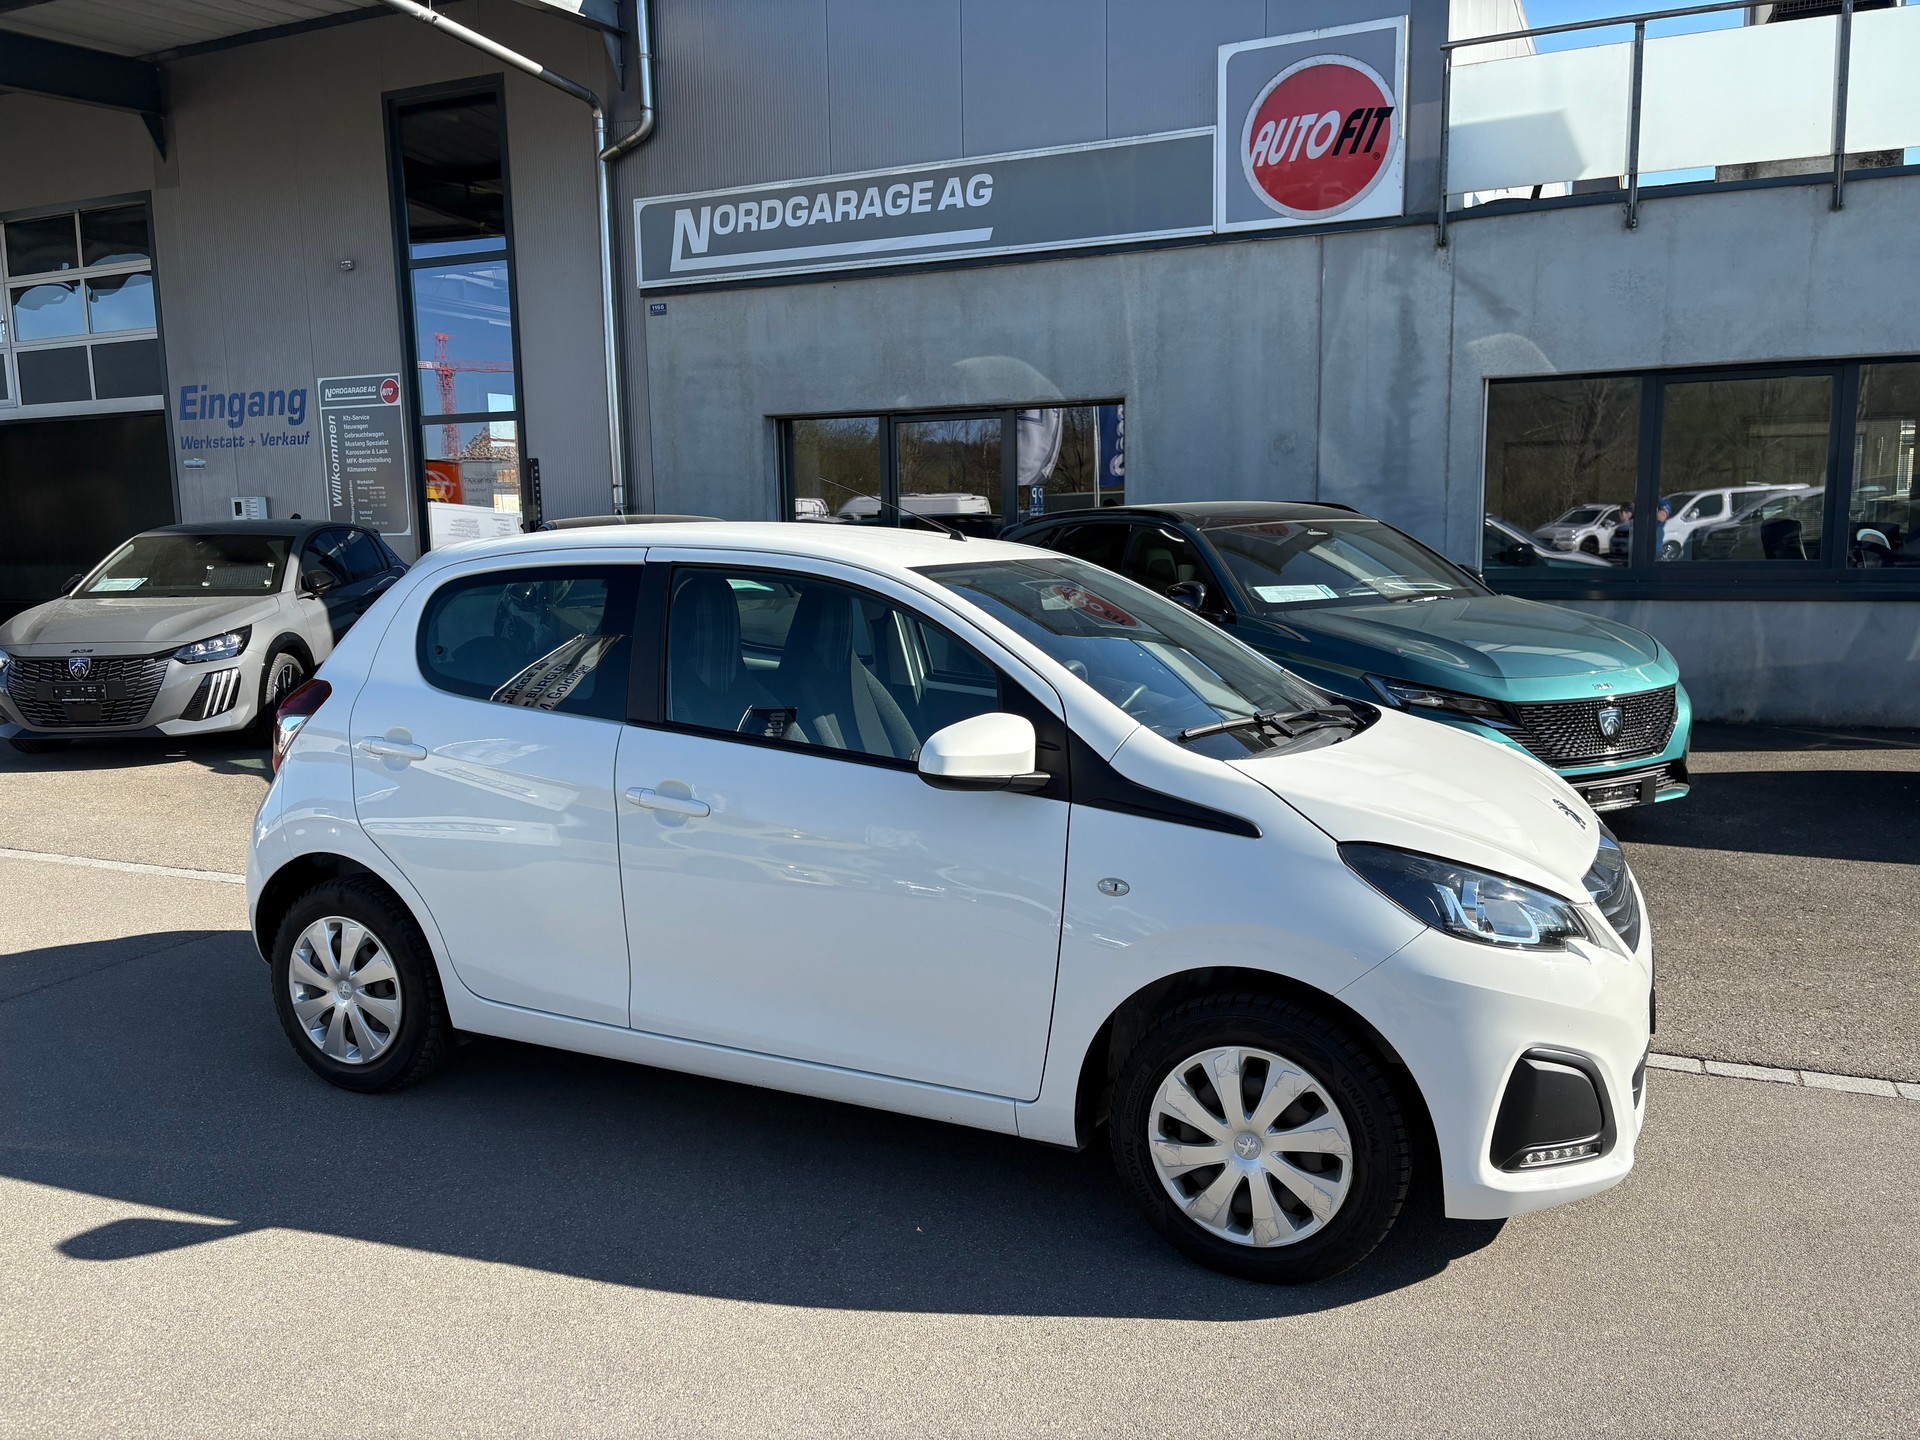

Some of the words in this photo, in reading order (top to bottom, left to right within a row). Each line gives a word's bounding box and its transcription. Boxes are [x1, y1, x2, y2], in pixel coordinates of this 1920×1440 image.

[1250, 107, 1395, 168] AUTOFIT
[670, 180, 933, 271] NORDGARAGE
[937, 173, 994, 210] AG
[179, 385, 307, 429] Eingang
[325, 386, 367, 401] NORDGARAGE
[180, 435, 245, 450] Werkstatt
[248, 437, 256, 447] +
[260, 431, 311, 447] Verkauf
[328, 415, 343, 508] Willkommen
[1340, 1076, 1382, 1159] UNIROYAL
